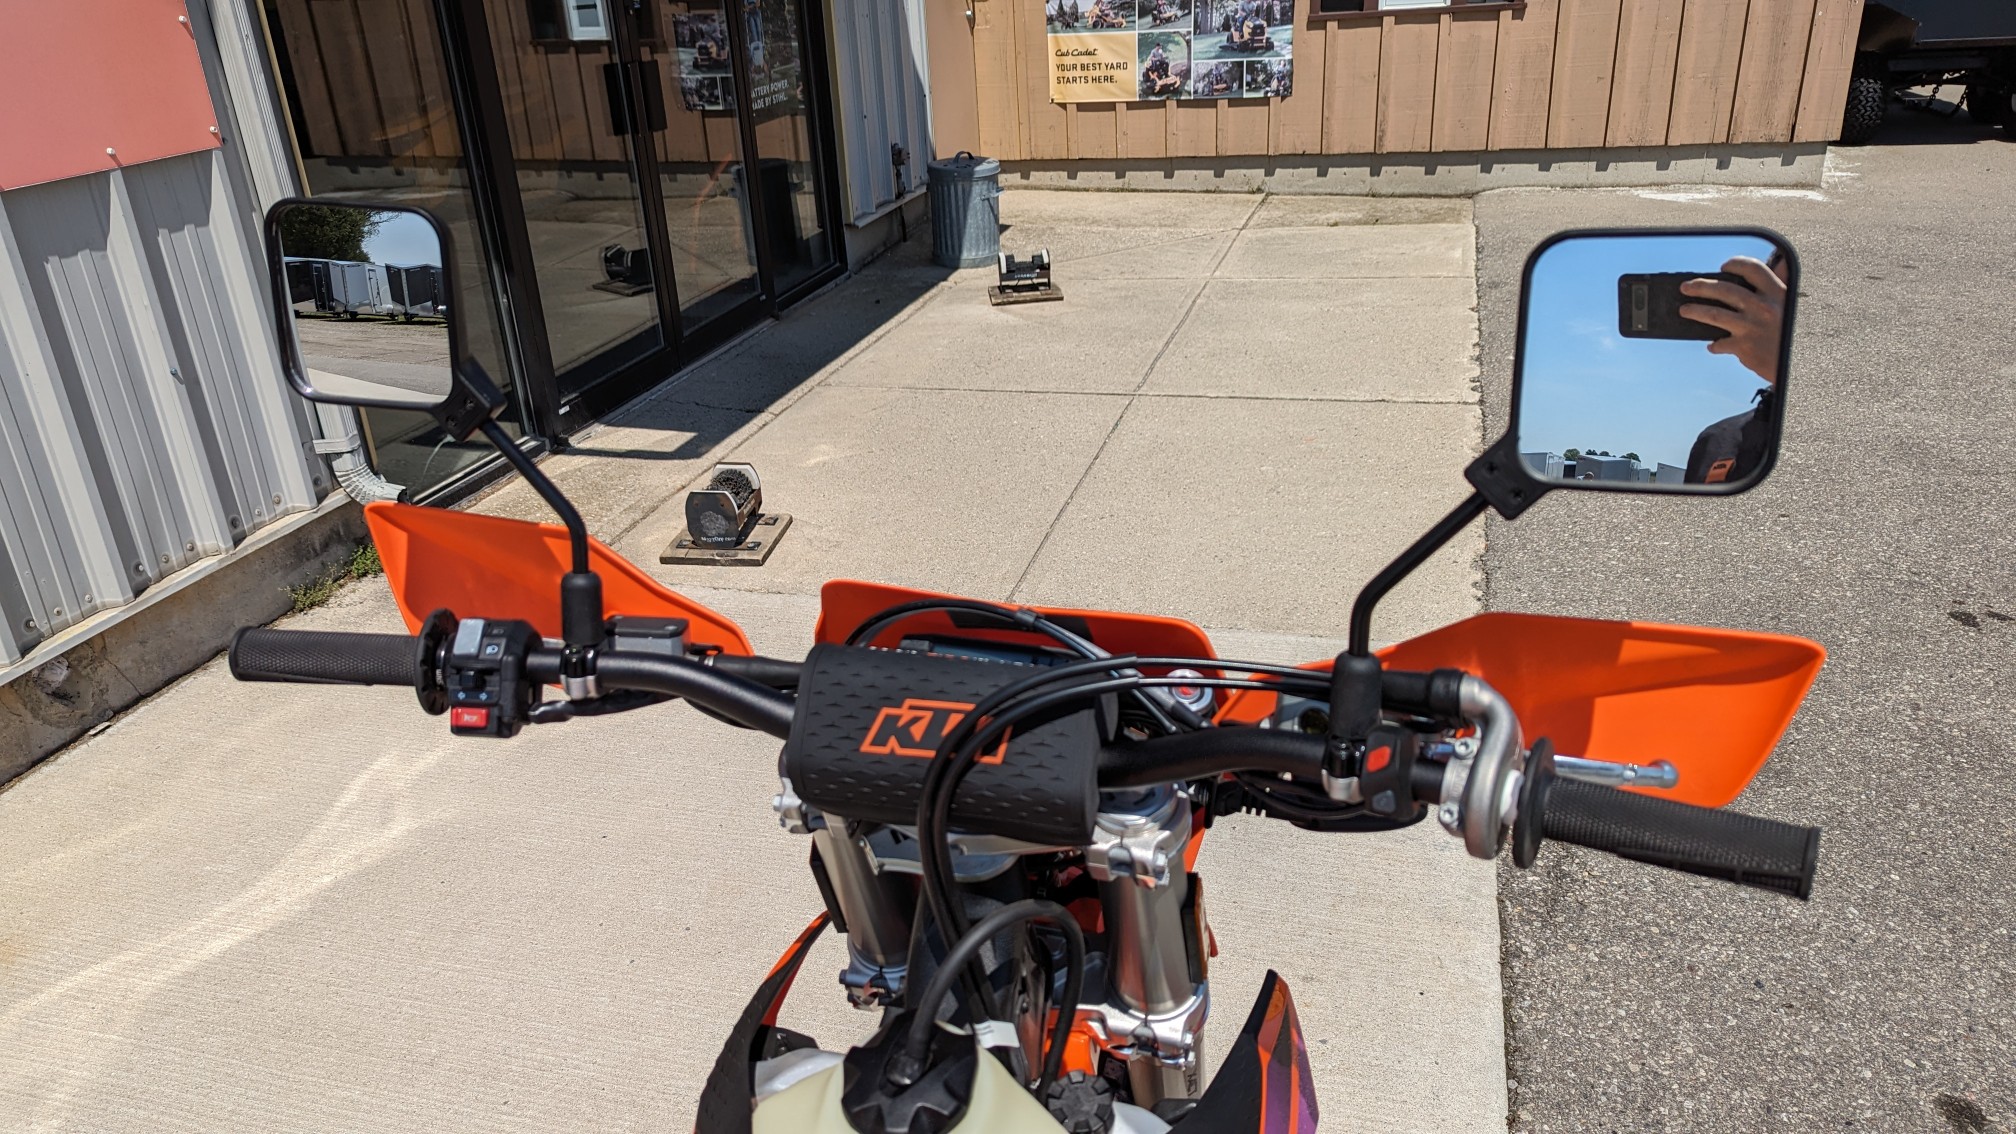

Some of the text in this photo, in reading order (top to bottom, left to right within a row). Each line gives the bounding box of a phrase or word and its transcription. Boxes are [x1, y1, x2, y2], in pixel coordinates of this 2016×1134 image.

[1055, 48, 1098, 57] Cub Cadet
[1055, 61, 1128, 72] YOUR BEST YARD
[1056, 75, 1118, 85] STARTS HERE.
[751, 84, 770, 98] ATTERY
